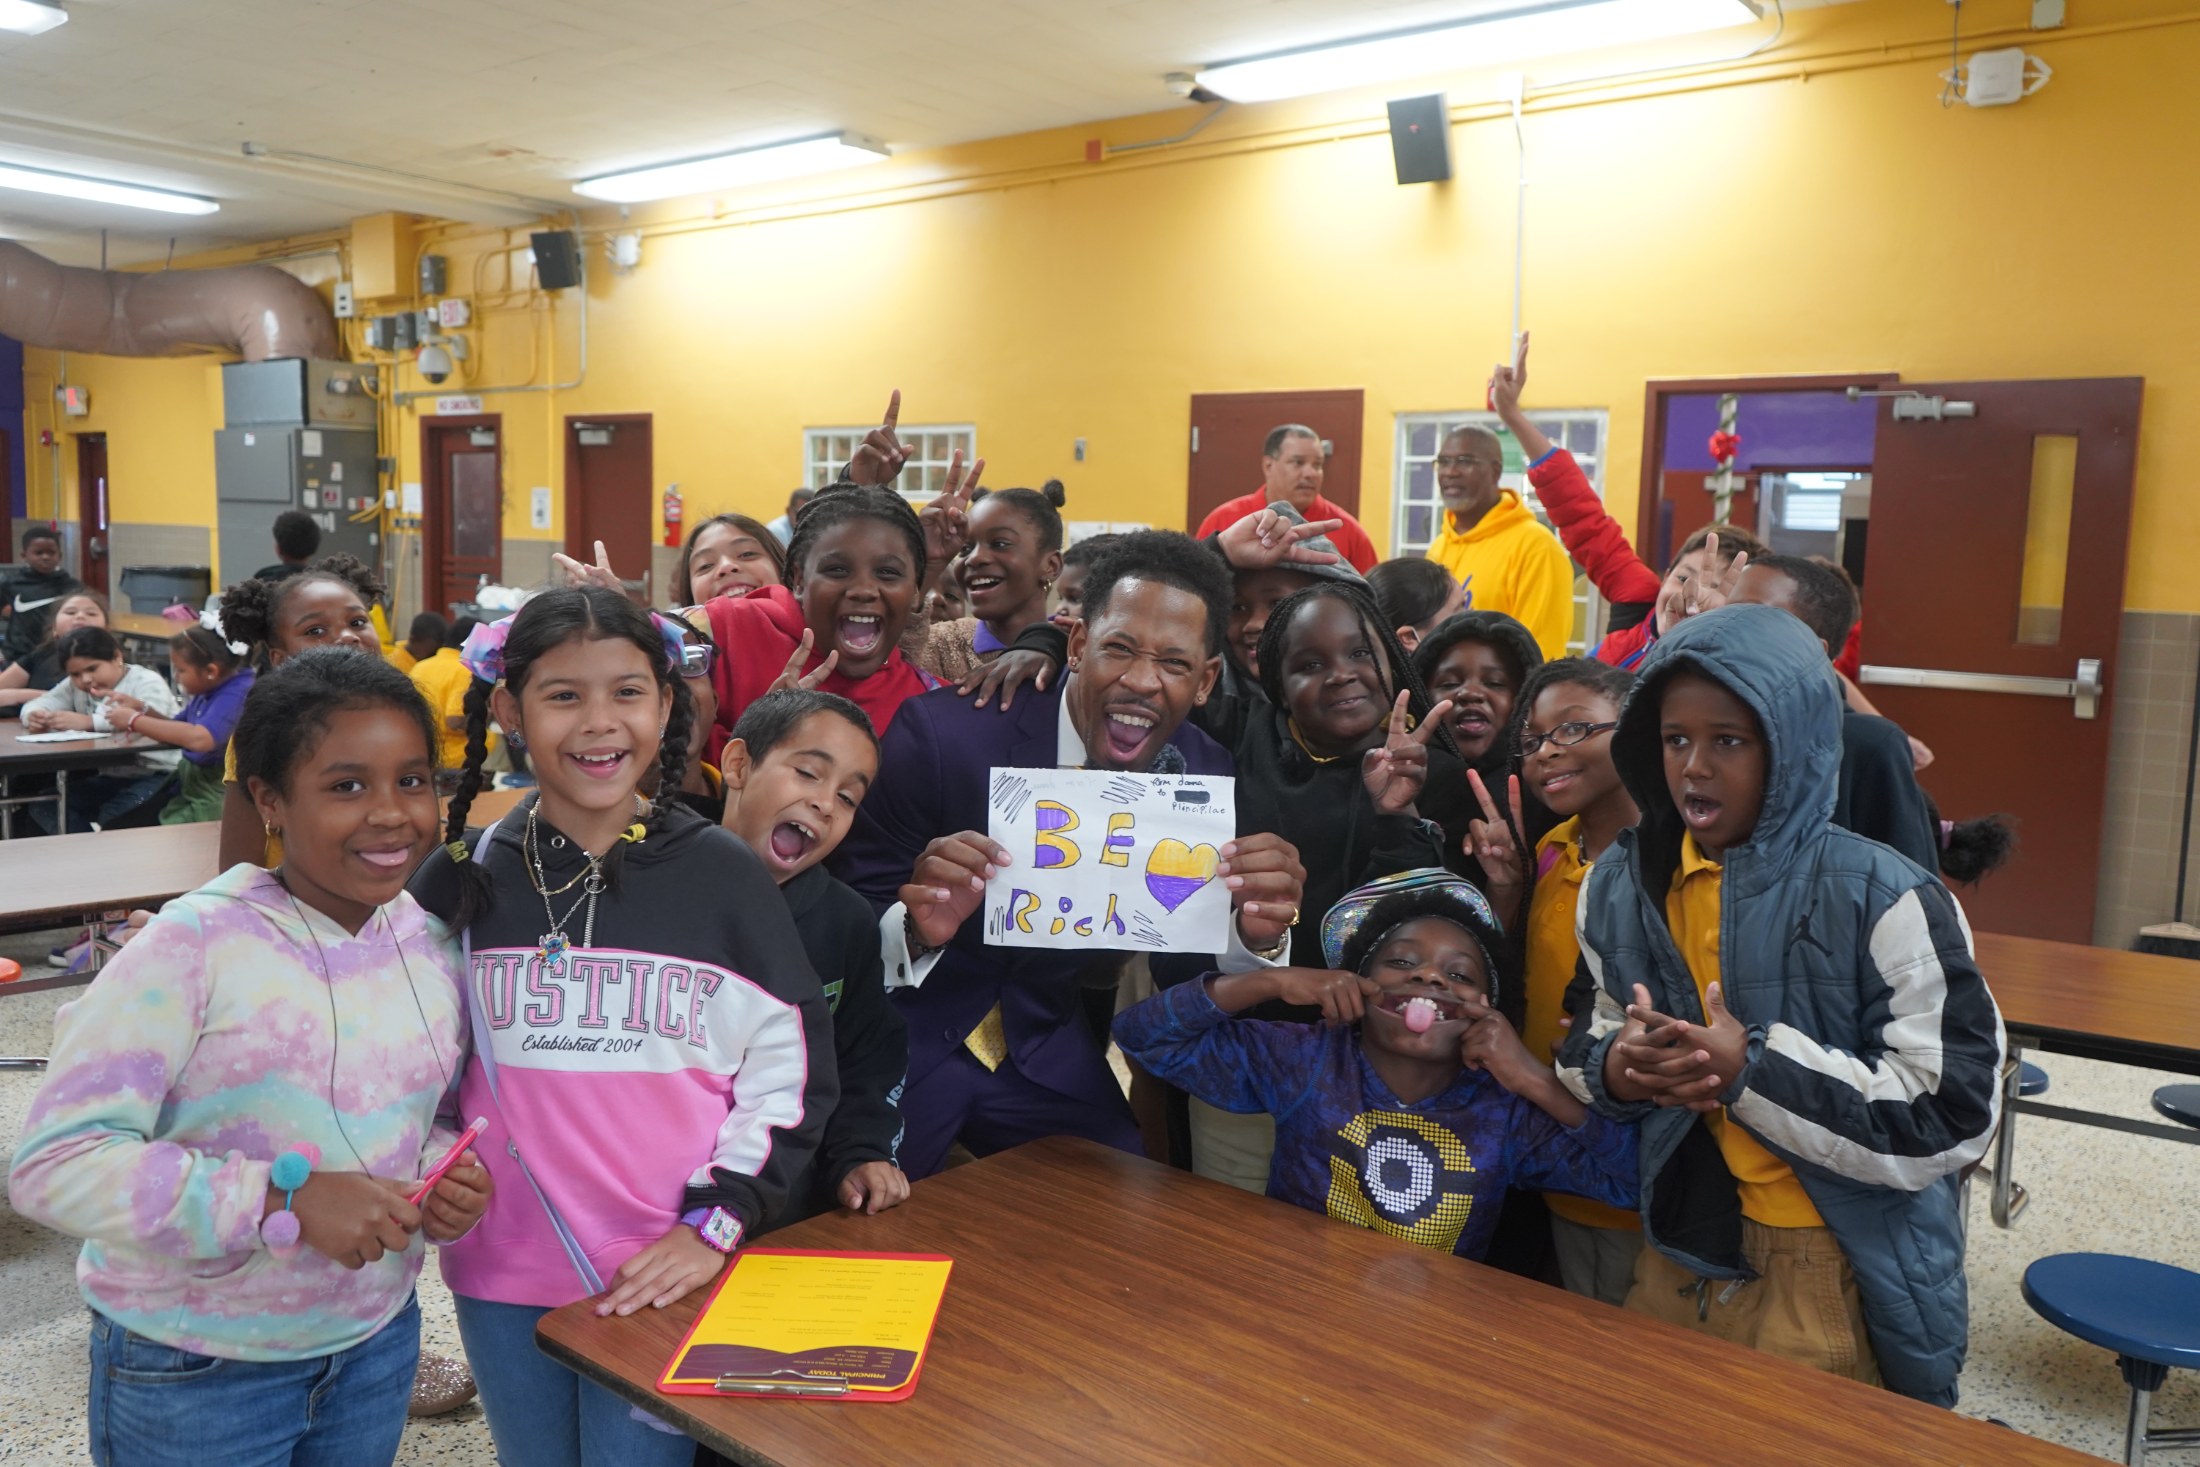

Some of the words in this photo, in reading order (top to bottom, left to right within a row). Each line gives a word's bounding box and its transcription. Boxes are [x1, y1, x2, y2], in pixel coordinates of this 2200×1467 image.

[1157, 788, 1166, 797] to
[1032, 800, 1136, 869] BE
[522, 1034, 602, 1053] Established
[603, 1038, 643, 1053] 2004
[808, 1369, 837, 1377] TODAY
[840, 1370, 886, 1379] PRINCIPAL
